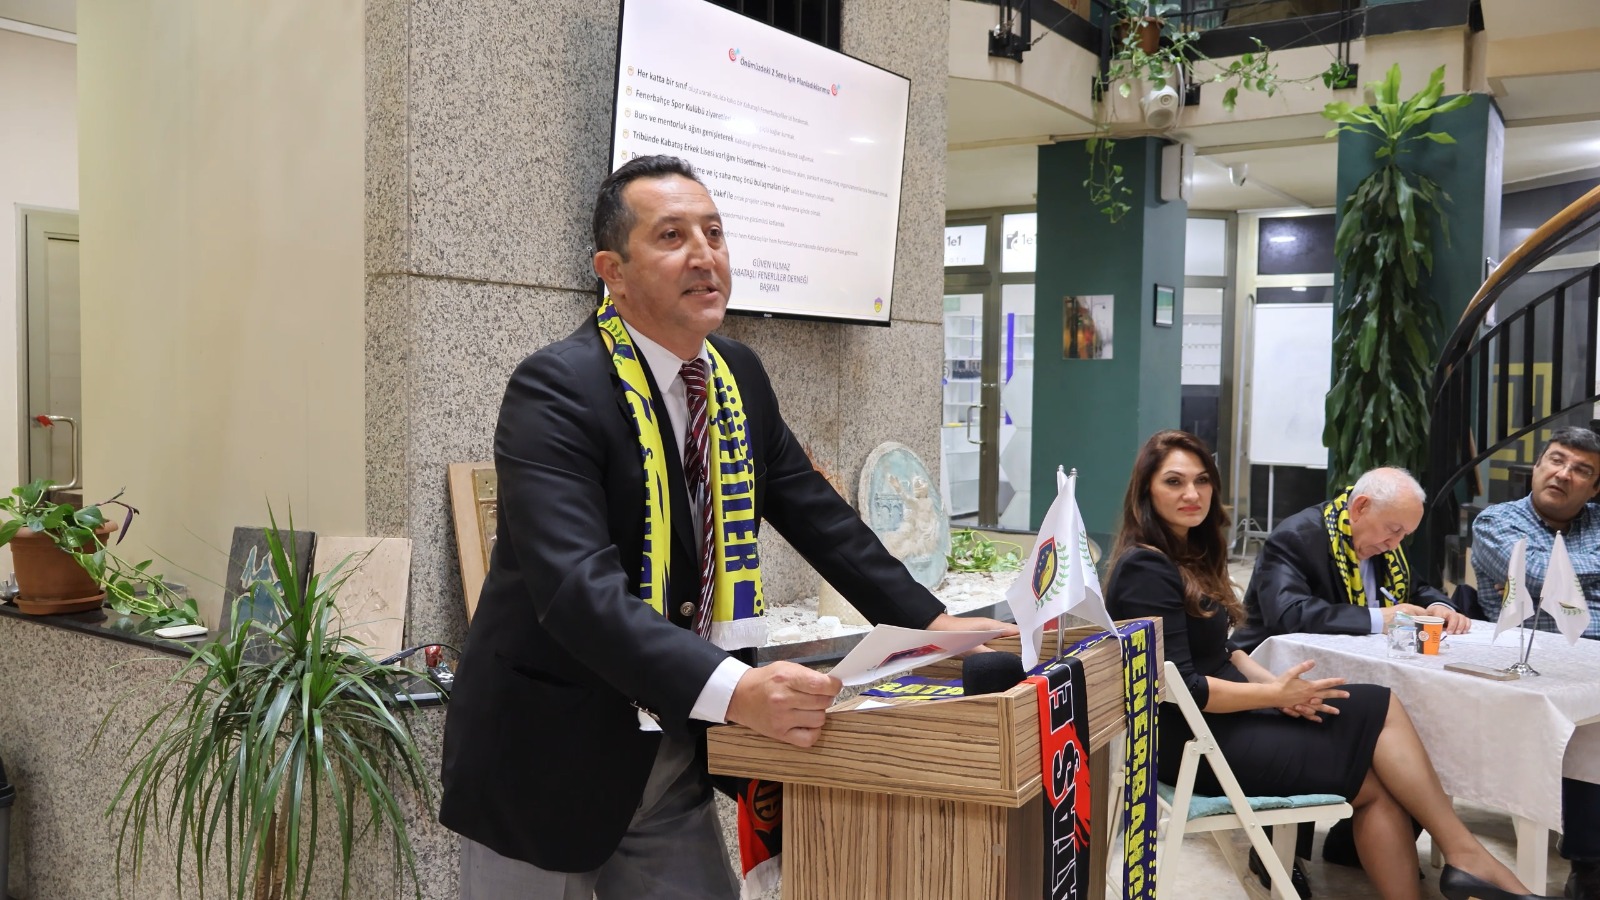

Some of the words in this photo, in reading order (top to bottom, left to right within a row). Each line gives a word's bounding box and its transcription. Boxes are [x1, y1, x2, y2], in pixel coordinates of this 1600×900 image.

[637, 68, 648, 79] Her
[649, 72, 665, 84] katta
[666, 76, 674, 86] bir
[675, 81, 688, 91] sınıf
[775, 70, 787, 81] Sene
[635, 89, 671, 107] Fenerbahçe
[671, 99, 685, 111] Spor
[685, 103, 705, 116] Kulübü
[634, 109, 648, 121] Burs
[649, 115, 657, 123] ve
[657, 117, 687, 130] mentorluk
[688, 124, 702, 135] ağını
[702, 129, 734, 143] genişleterek
[632, 130, 660, 144] Tribünde
[660, 136, 683, 151] Kabataş
[684, 142, 700, 154] Erkek
[700, 147, 715, 157] Lisesi
[736, 155, 767, 170] hissettirmek
[705, 169, 713, 177] ve
[713, 169, 718, 179] iç
[719, 171, 731, 181] saha
[731, 175, 743, 185] maç
[946, 234, 962, 247] 1e1
[752, 257, 771, 269] GÜVEN
[772, 260, 791, 271] YILMAZ
[757, 270, 787, 282] FENERLİLER
[787, 273, 809, 285] DERNEĞİ
[759, 282, 780, 293] BAŞKAN
[1127, 628, 1149, 900] FENERBAHÇ
